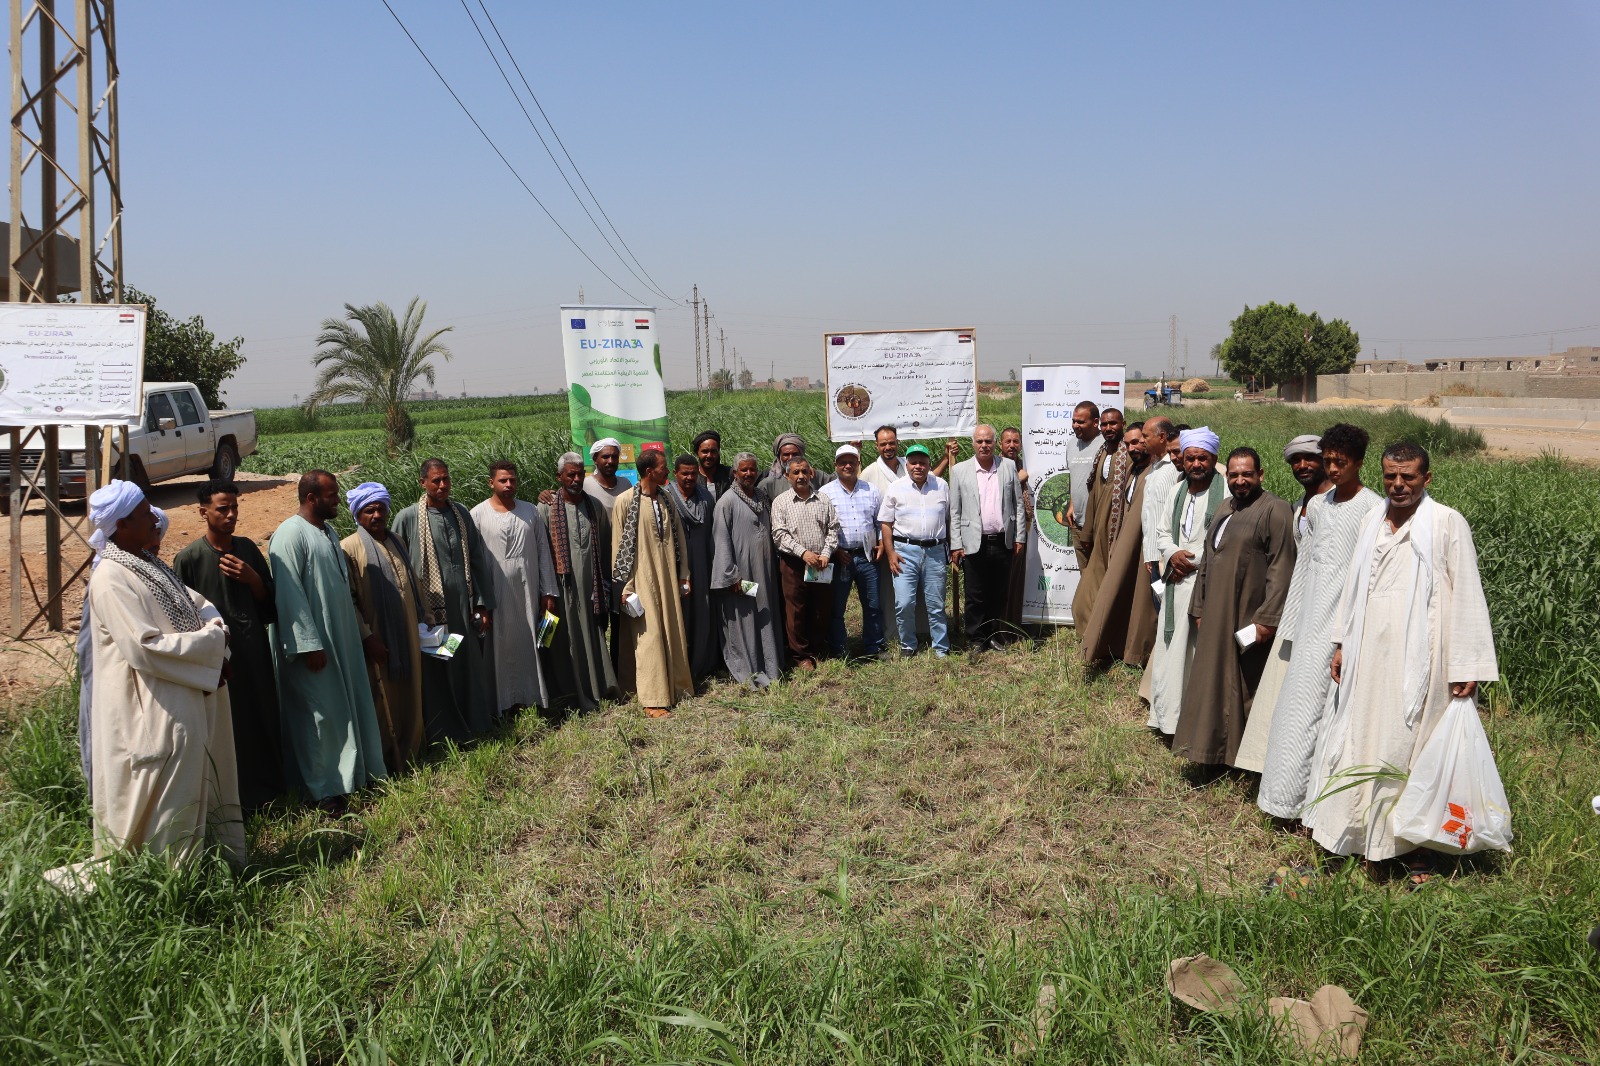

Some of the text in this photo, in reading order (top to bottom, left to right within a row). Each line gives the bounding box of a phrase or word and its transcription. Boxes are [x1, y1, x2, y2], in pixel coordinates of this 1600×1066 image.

[580, 338, 644, 349] EU-ZIRA3A
[1046, 410, 1072, 419] EU-ZI
[1034, 438, 1054, 447] والتدريب
[1051, 545, 1075, 556] Forage
[1054, 564, 1062, 572] من
